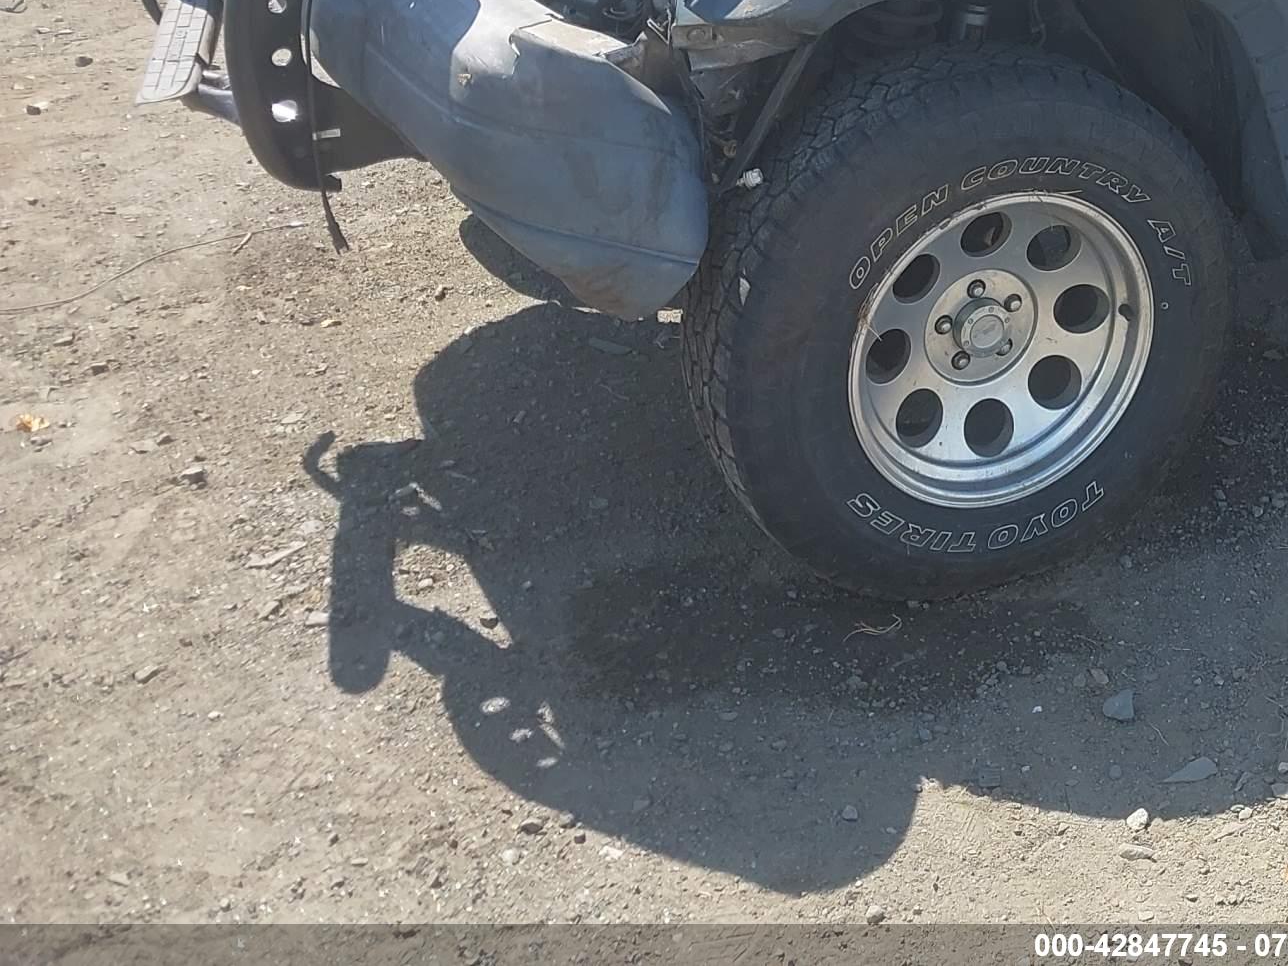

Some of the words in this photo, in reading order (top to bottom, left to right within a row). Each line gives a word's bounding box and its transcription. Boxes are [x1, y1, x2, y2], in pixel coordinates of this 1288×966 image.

[849, 183, 950, 290] OPEN
[960, 156, 1152, 204] COUNTRY
[1147, 219, 1192, 286] A/T
[846, 492, 976, 553] TIRES
[987, 480, 1105, 551] TOYO
